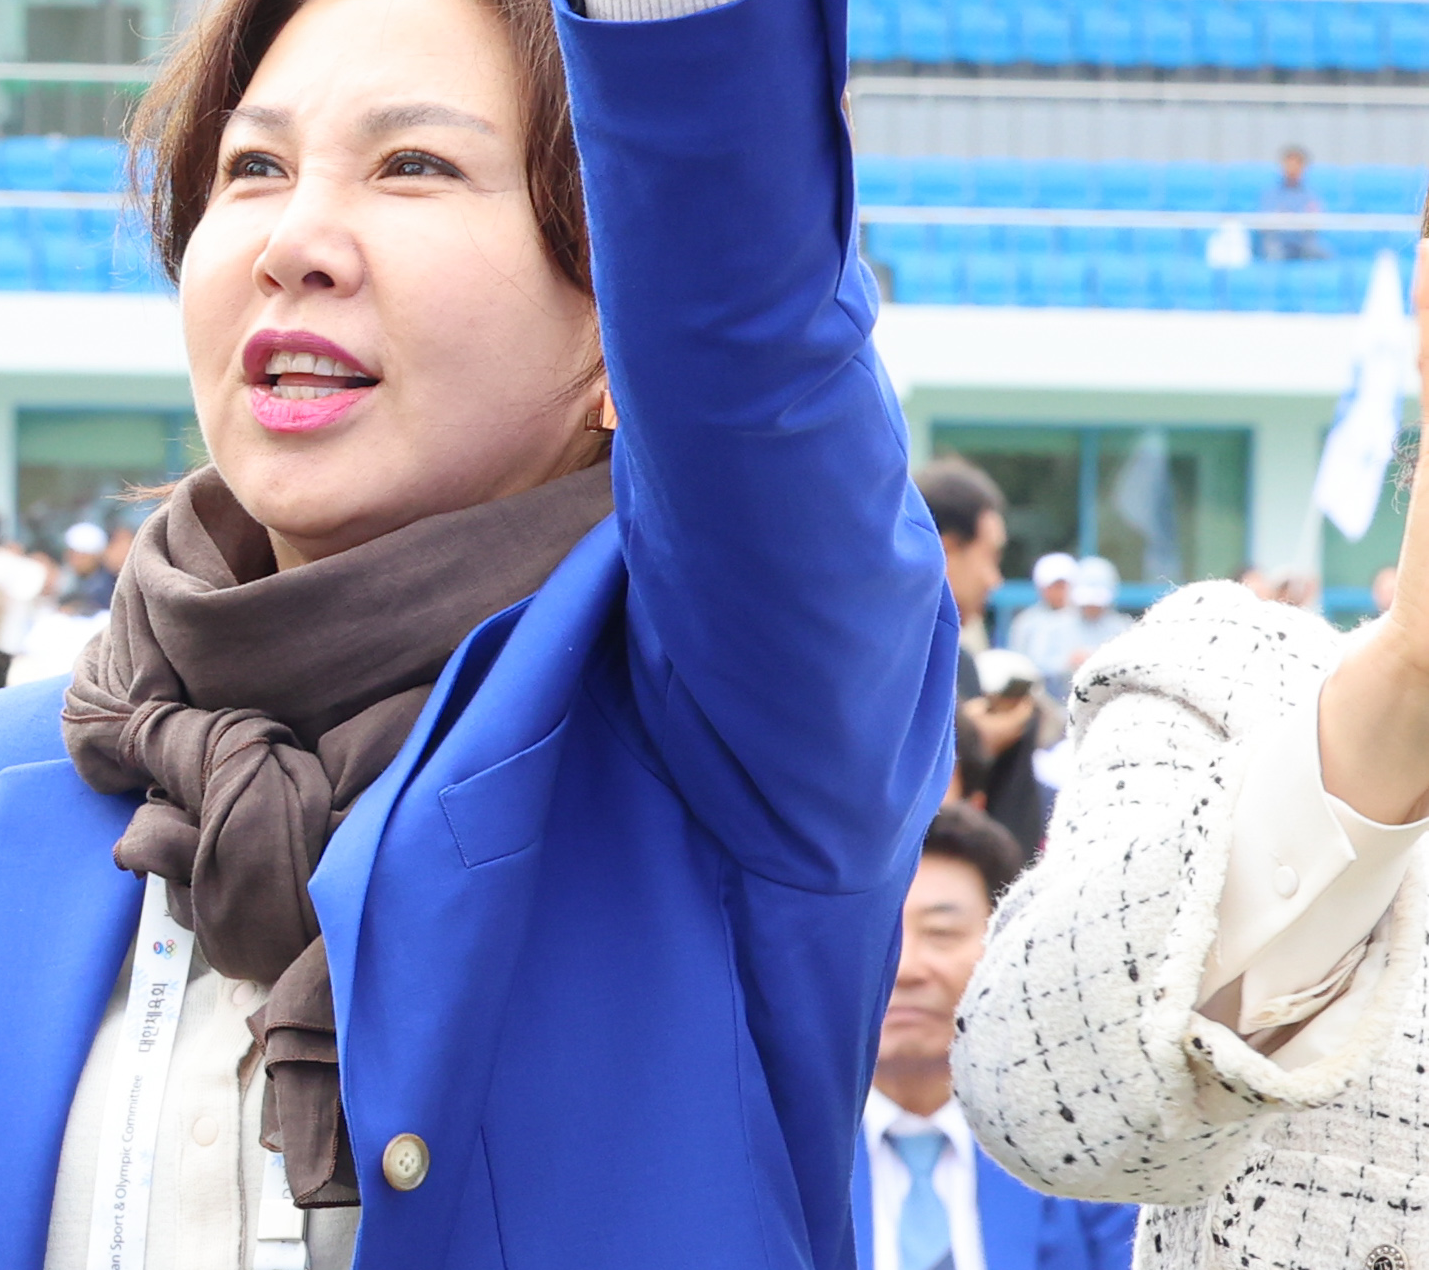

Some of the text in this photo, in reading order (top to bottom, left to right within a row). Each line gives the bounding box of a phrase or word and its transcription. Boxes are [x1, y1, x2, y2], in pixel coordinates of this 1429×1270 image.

[137, 982, 169, 1053] 대한체육회
[122, 1074, 144, 1143] Committee
[115, 1145, 133, 1200] Olympic
[109, 1213, 125, 1251] Sport
[114, 1202, 126, 1212] &
